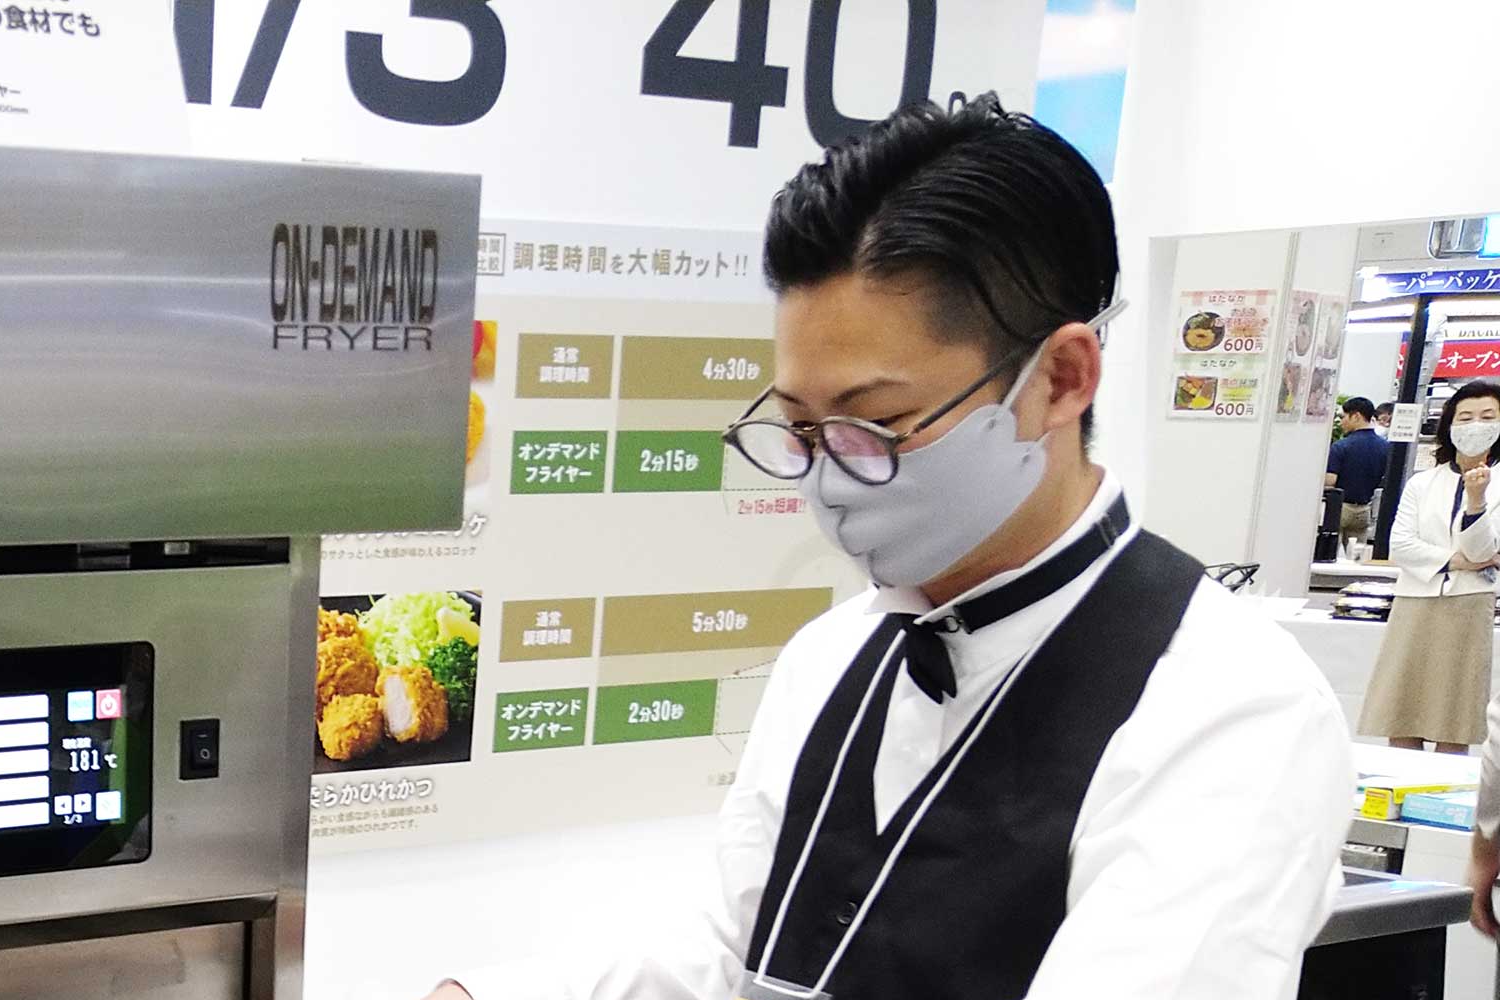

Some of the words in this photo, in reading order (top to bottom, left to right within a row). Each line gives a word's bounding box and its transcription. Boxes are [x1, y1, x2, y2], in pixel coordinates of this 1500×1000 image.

[271, 223, 438, 323] ON-DEMAND
[272, 324, 433, 350] FRYER
[702, 356, 761, 381] 4分30秒
[518, 442, 600, 461] オンデマンド
[639, 449, 699, 473] 2分15秒
[525, 465, 593, 484] フライヤー
[534, 610, 562, 628] 通常
[691, 609, 749, 634] 5分30秒
[522, 628, 573, 647] 調理時間
[500, 697, 582, 722] オンデマンド
[627, 699, 685, 724] 2分30秒
[507, 722, 574, 742] フライヤー
[69, 749, 101, 773] 181
